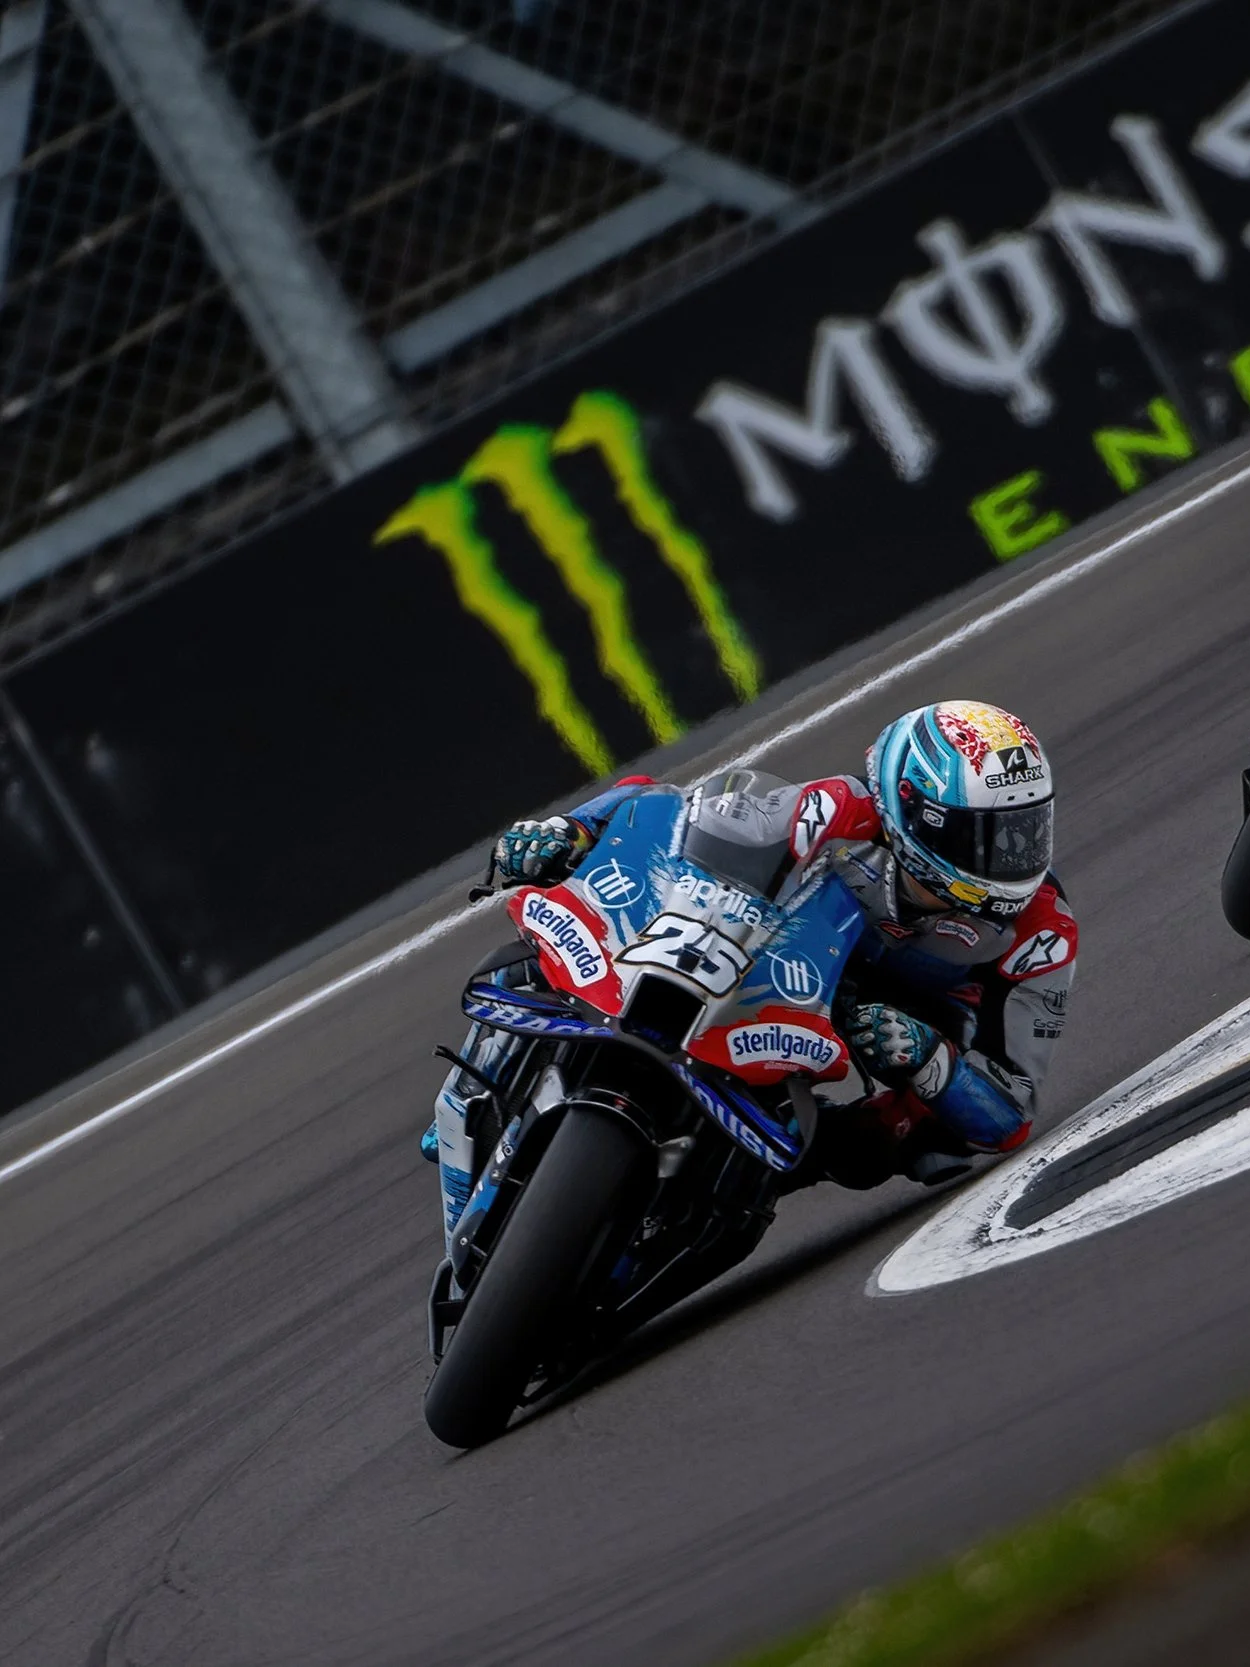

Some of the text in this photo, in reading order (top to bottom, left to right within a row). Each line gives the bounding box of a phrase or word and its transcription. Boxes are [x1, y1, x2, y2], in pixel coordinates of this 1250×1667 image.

[985, 765, 1046, 789] SHARK
[674, 874, 763, 928] aprilia
[991, 899, 1030, 915] apri
[525, 898, 600, 980] sterilgarda
[614, 911, 755, 998] 25
[732, 1025, 834, 1064] sterilgarda
